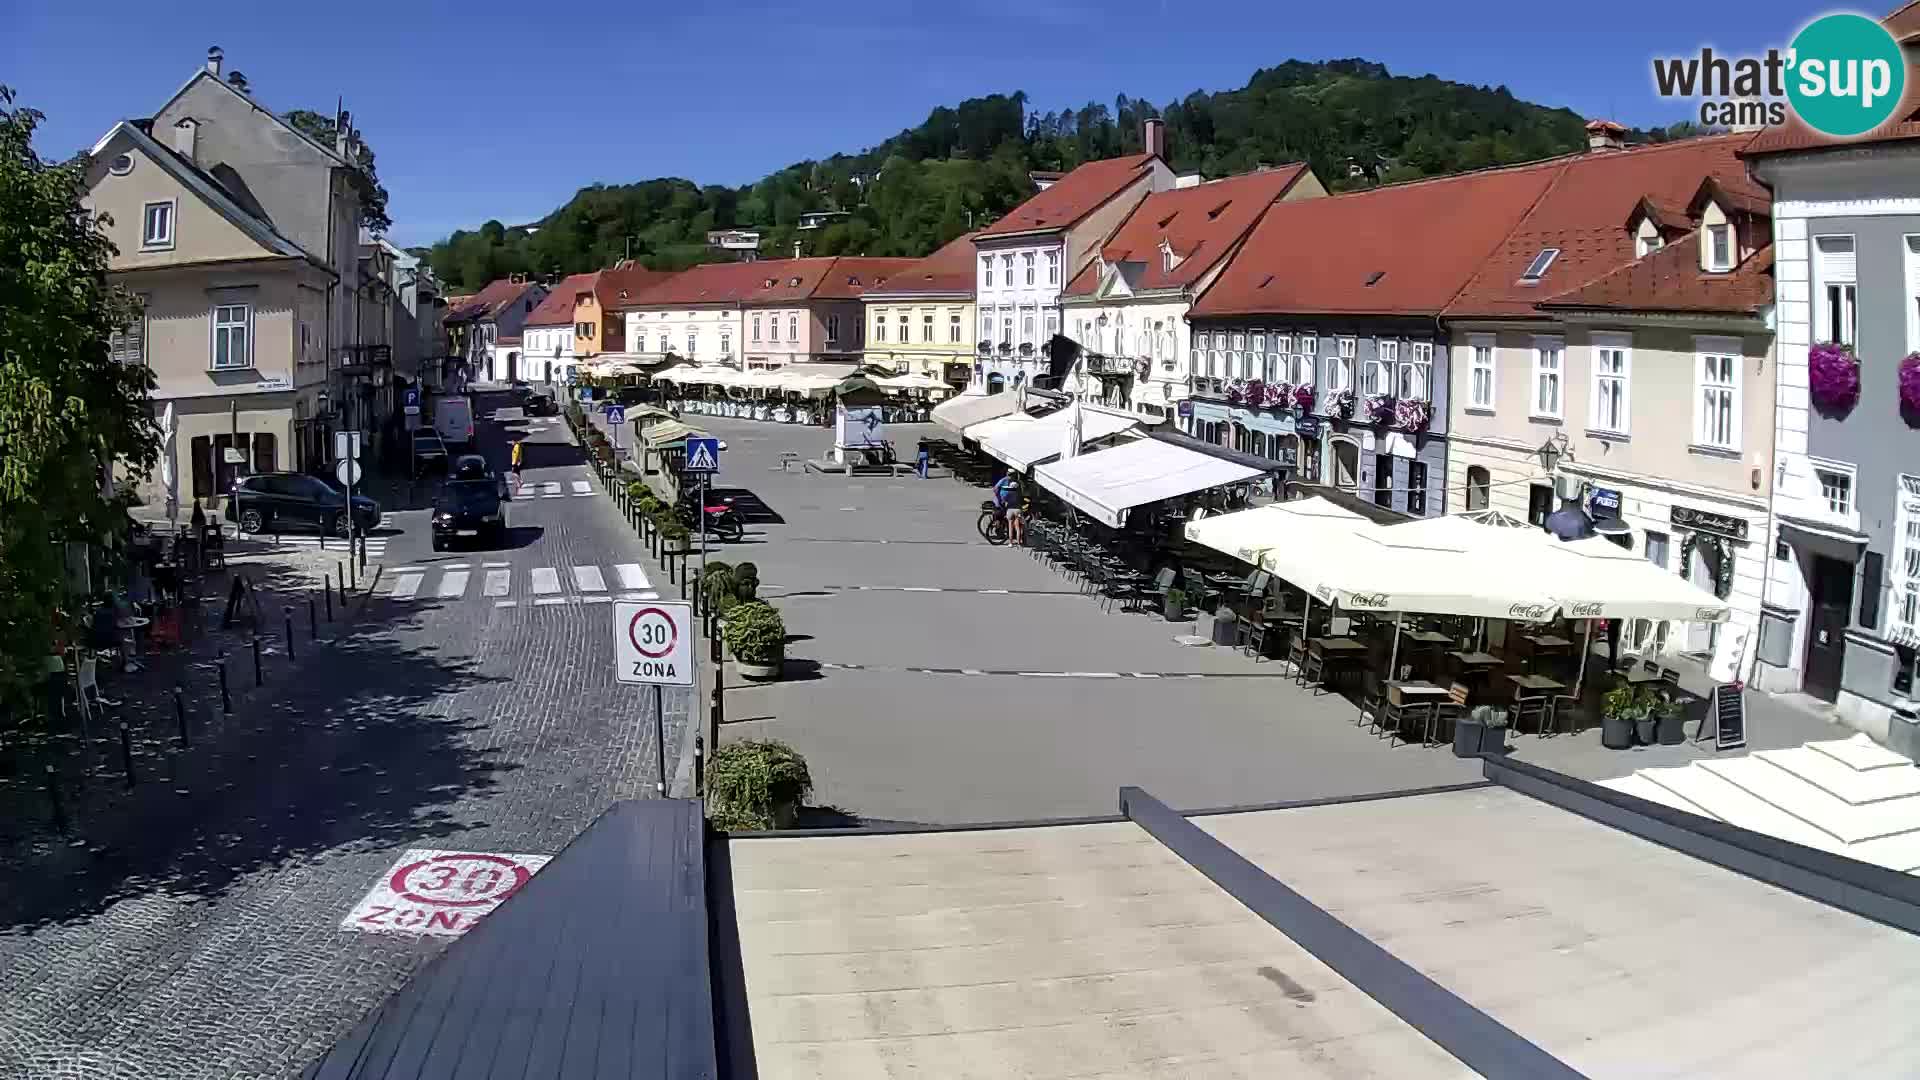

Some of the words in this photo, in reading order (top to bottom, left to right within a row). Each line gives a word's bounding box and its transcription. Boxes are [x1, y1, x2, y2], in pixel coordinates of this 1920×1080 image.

[408, 392, 416, 404] P
[642, 623, 666, 645] 30
[632, 661, 677, 678] ZONA
[418, 866, 502, 894] 30
[359, 904, 480, 930] ZON
